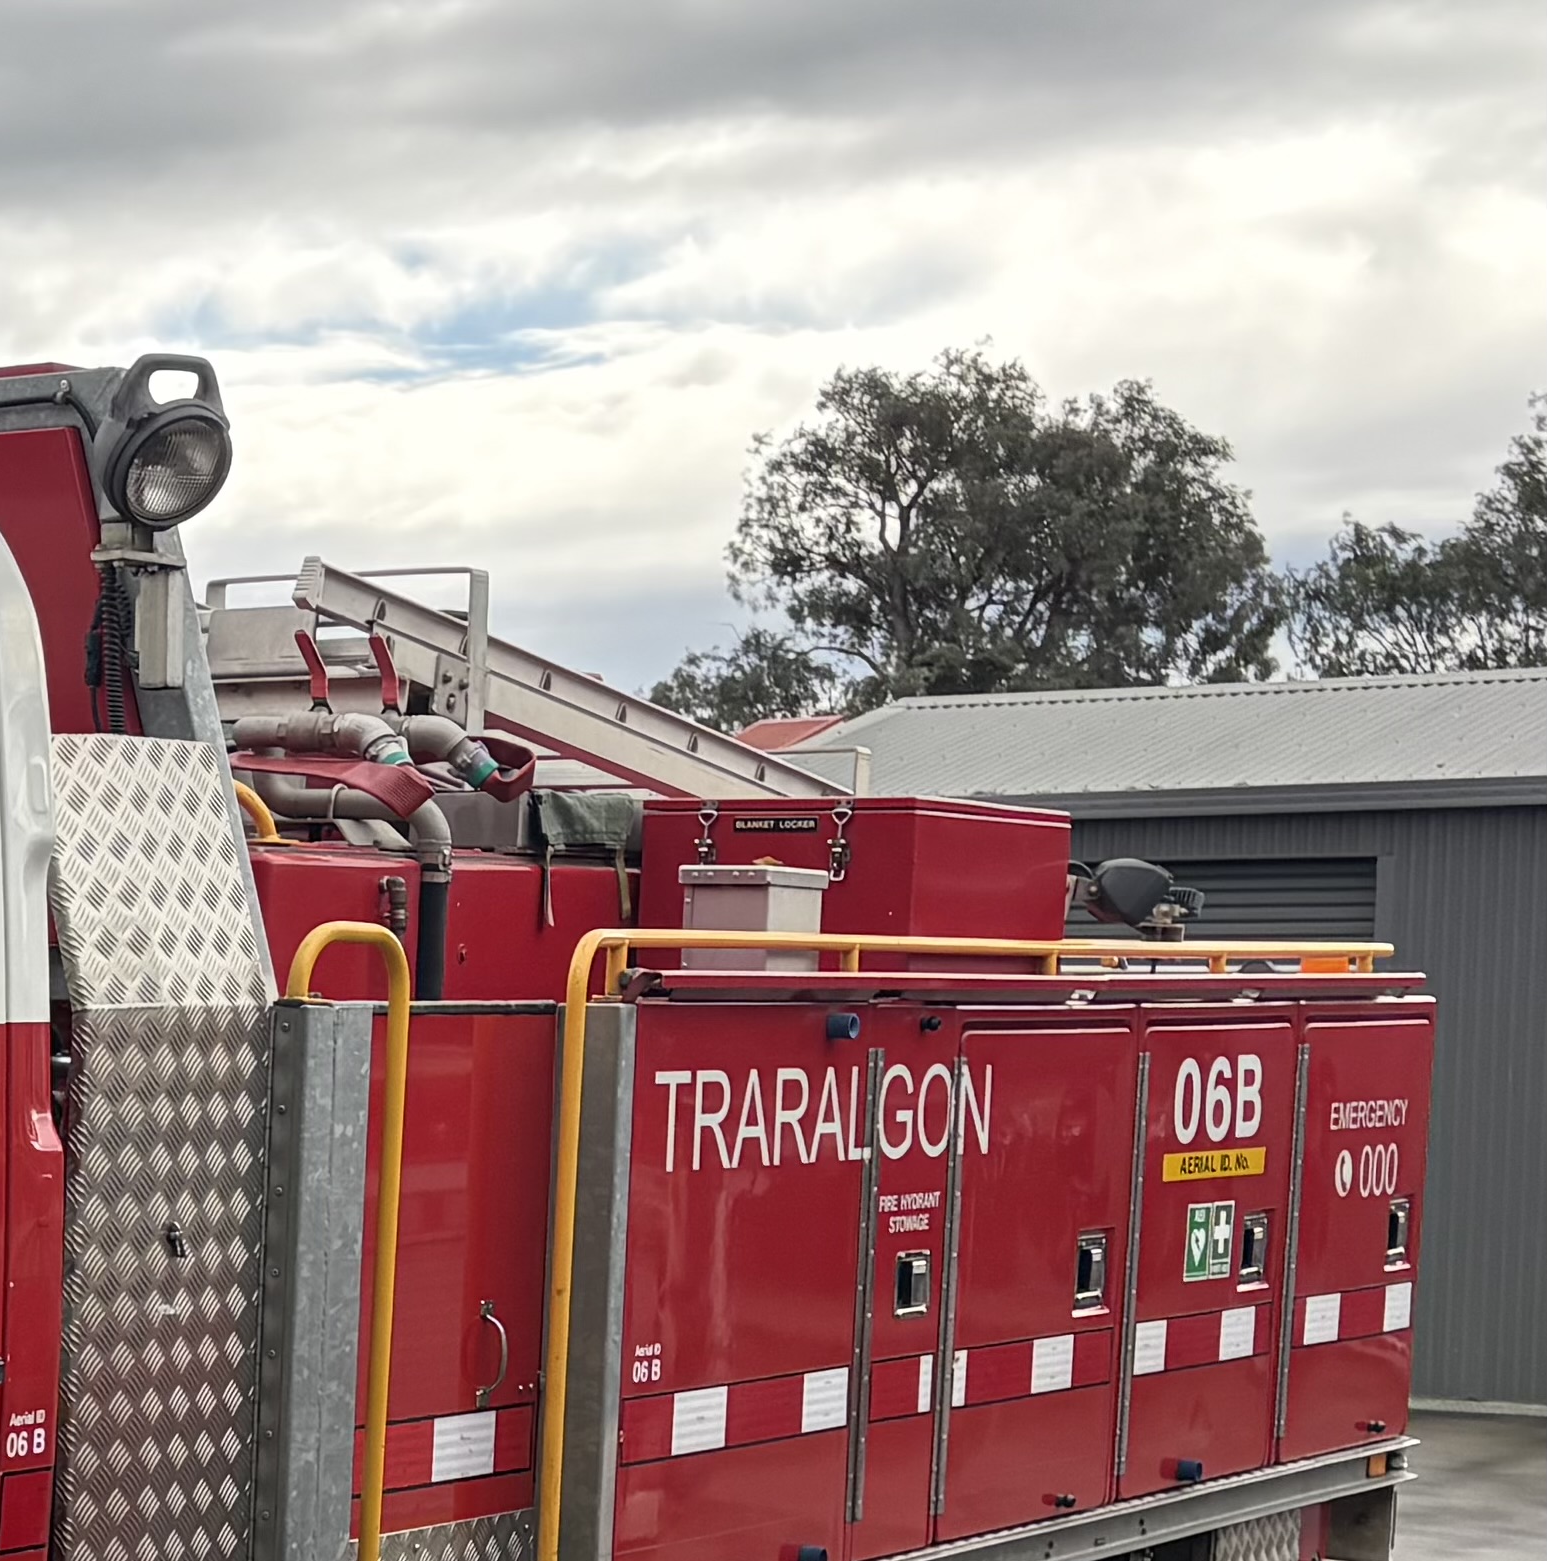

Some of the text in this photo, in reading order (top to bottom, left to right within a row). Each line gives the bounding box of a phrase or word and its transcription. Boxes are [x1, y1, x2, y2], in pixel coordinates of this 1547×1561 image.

[735, 820, 816, 829] BLANKET LOCKER
[1174, 1054, 1263, 1145] 06B
[655, 1062, 992, 1172] TRARALGON
[1330, 1099, 1409, 1131] EMERGENCY
[1179, 1154, 1216, 1175] AERIAL
[1359, 1142, 1399, 1198] 000
[878, 1190, 942, 1213] FIRE HYDRANT
[888, 1213, 930, 1234] STOWAGE
[632, 1358, 661, 1383] 06 B
[9, 1410, 35, 1427] Aerial
[6, 1427, 46, 1458] 06 B
